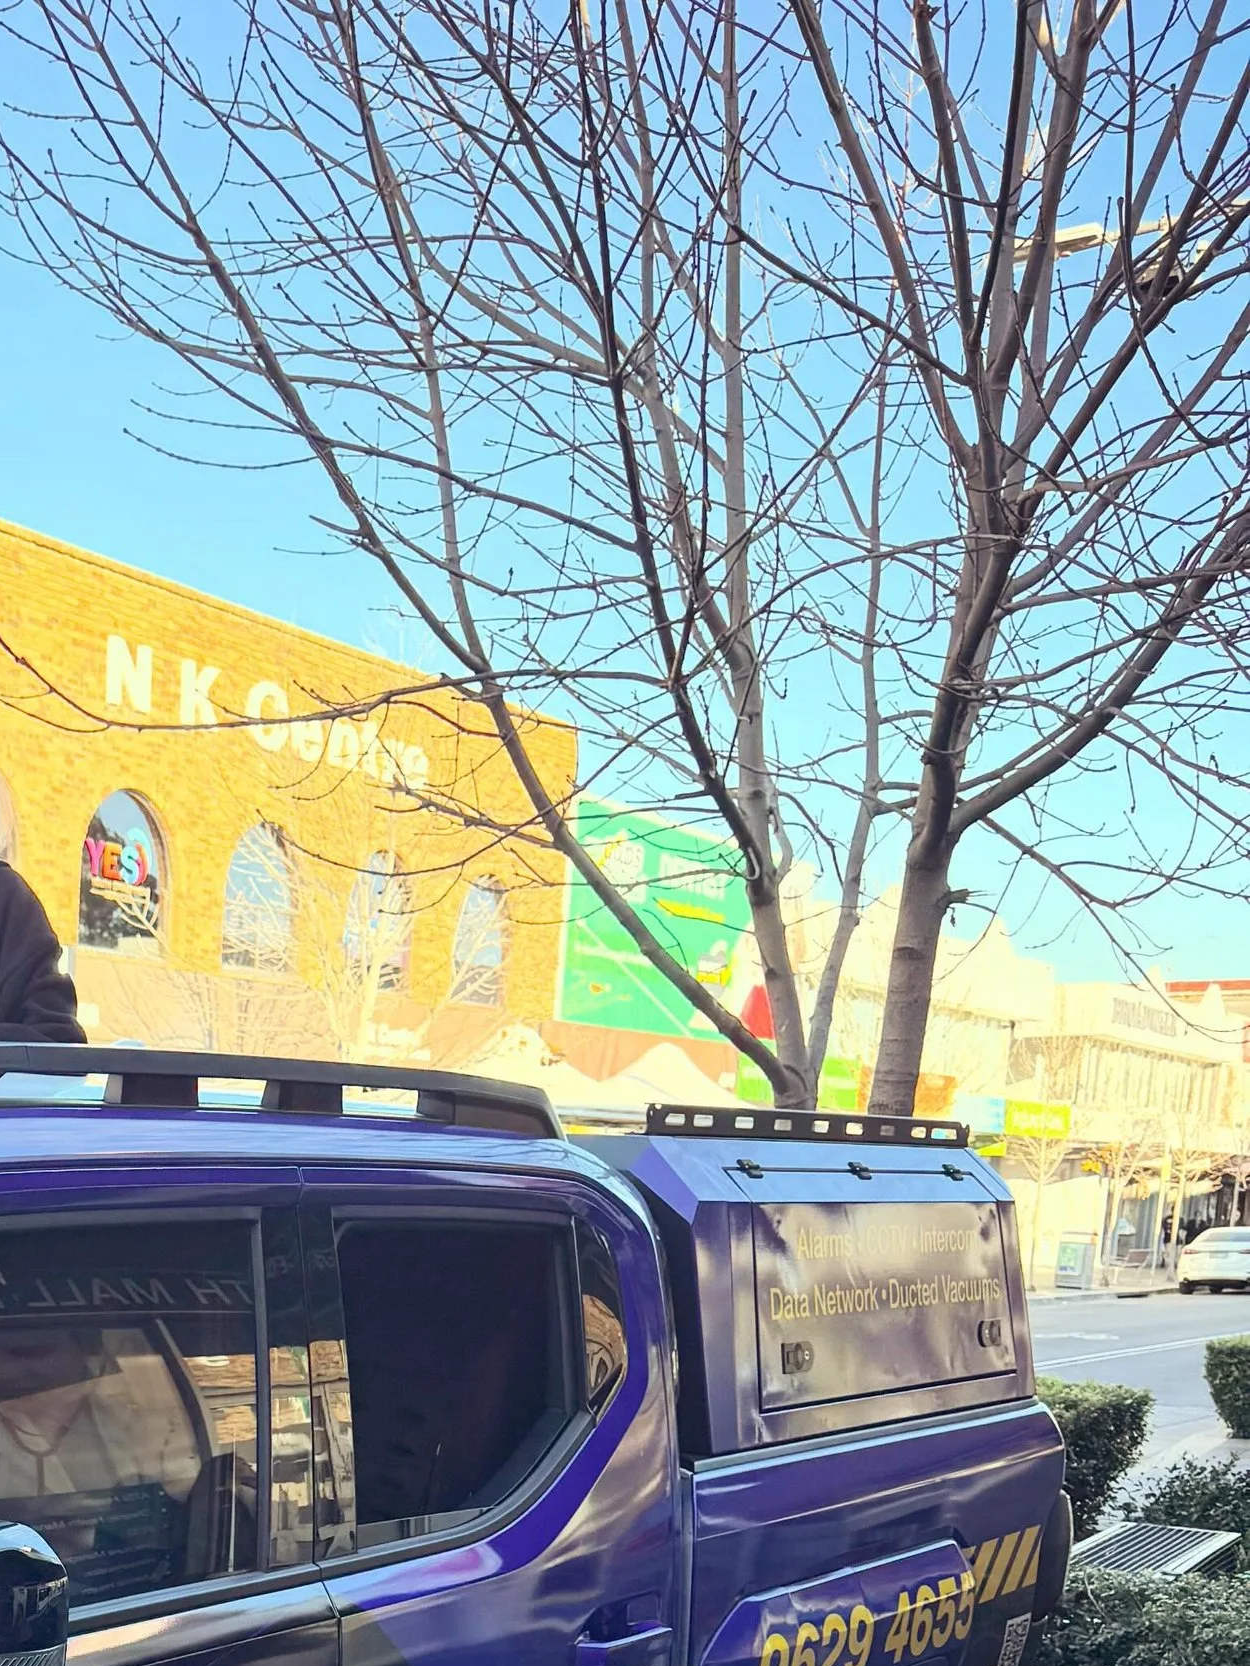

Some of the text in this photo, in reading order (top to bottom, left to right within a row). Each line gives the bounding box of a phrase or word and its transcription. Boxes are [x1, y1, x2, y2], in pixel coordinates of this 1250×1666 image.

[105, 634, 429, 790] N K Centre
[85, 837, 149, 886] YES
[797, 1227, 854, 1260] Alarms
[769, 1274, 1000, 1321] Data Network Ducted Vacuums
[884, 1569, 977, 1664] 4655
